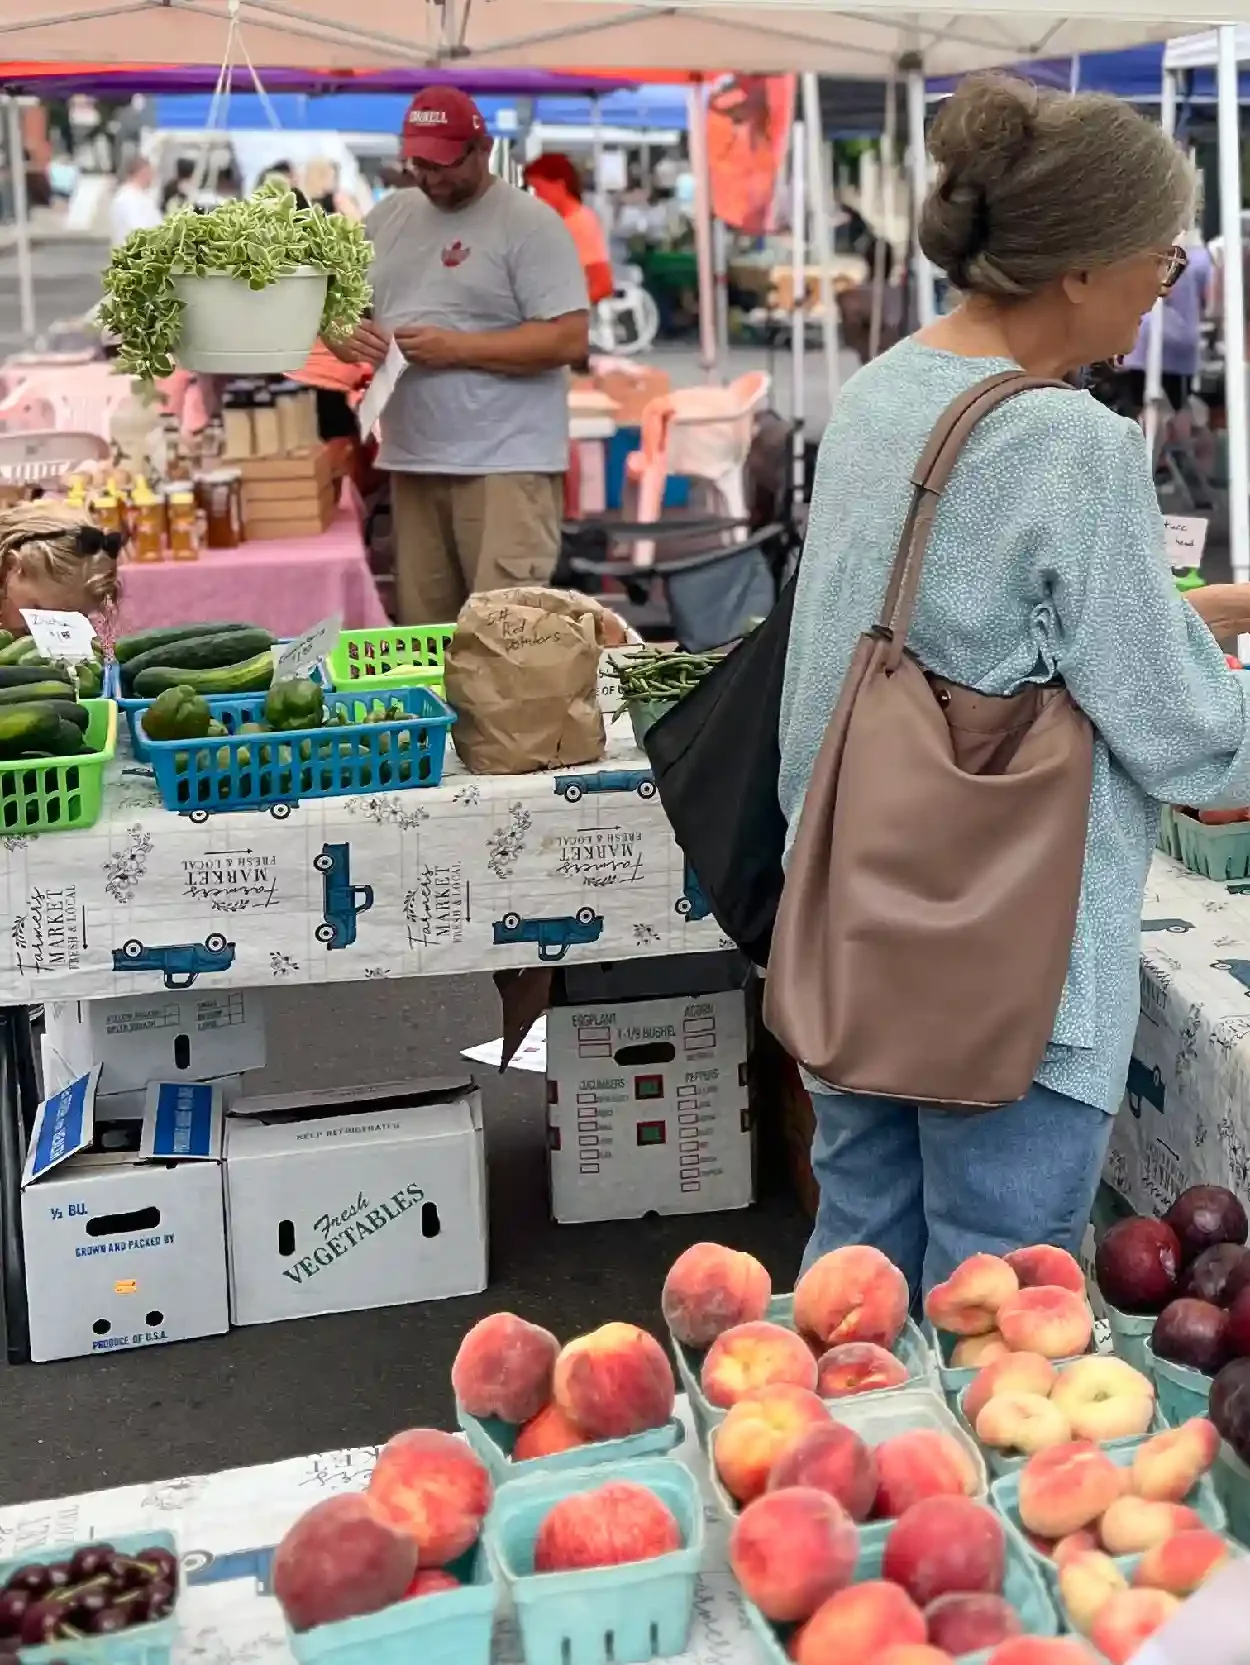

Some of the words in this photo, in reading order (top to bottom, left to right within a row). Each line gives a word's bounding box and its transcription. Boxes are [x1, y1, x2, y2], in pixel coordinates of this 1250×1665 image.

[559, 843, 633, 862] MARKET
[184, 868, 268, 886] MARKET
[435, 865, 450, 937] MARKET
[46, 888, 65, 964] MARKET
[282, 1182, 425, 1284] VEGETABLES
[313, 1190, 371, 1241] Fresh
[75, 1244, 106, 1258] GROWN
[108, 1241, 126, 1253] AND
[128, 1235, 161, 1250] PACKED
[163, 1233, 175, 1245] BY
[92, 1336, 129, 1350] PRODUCE
[132, 1332, 144, 1344] OF
